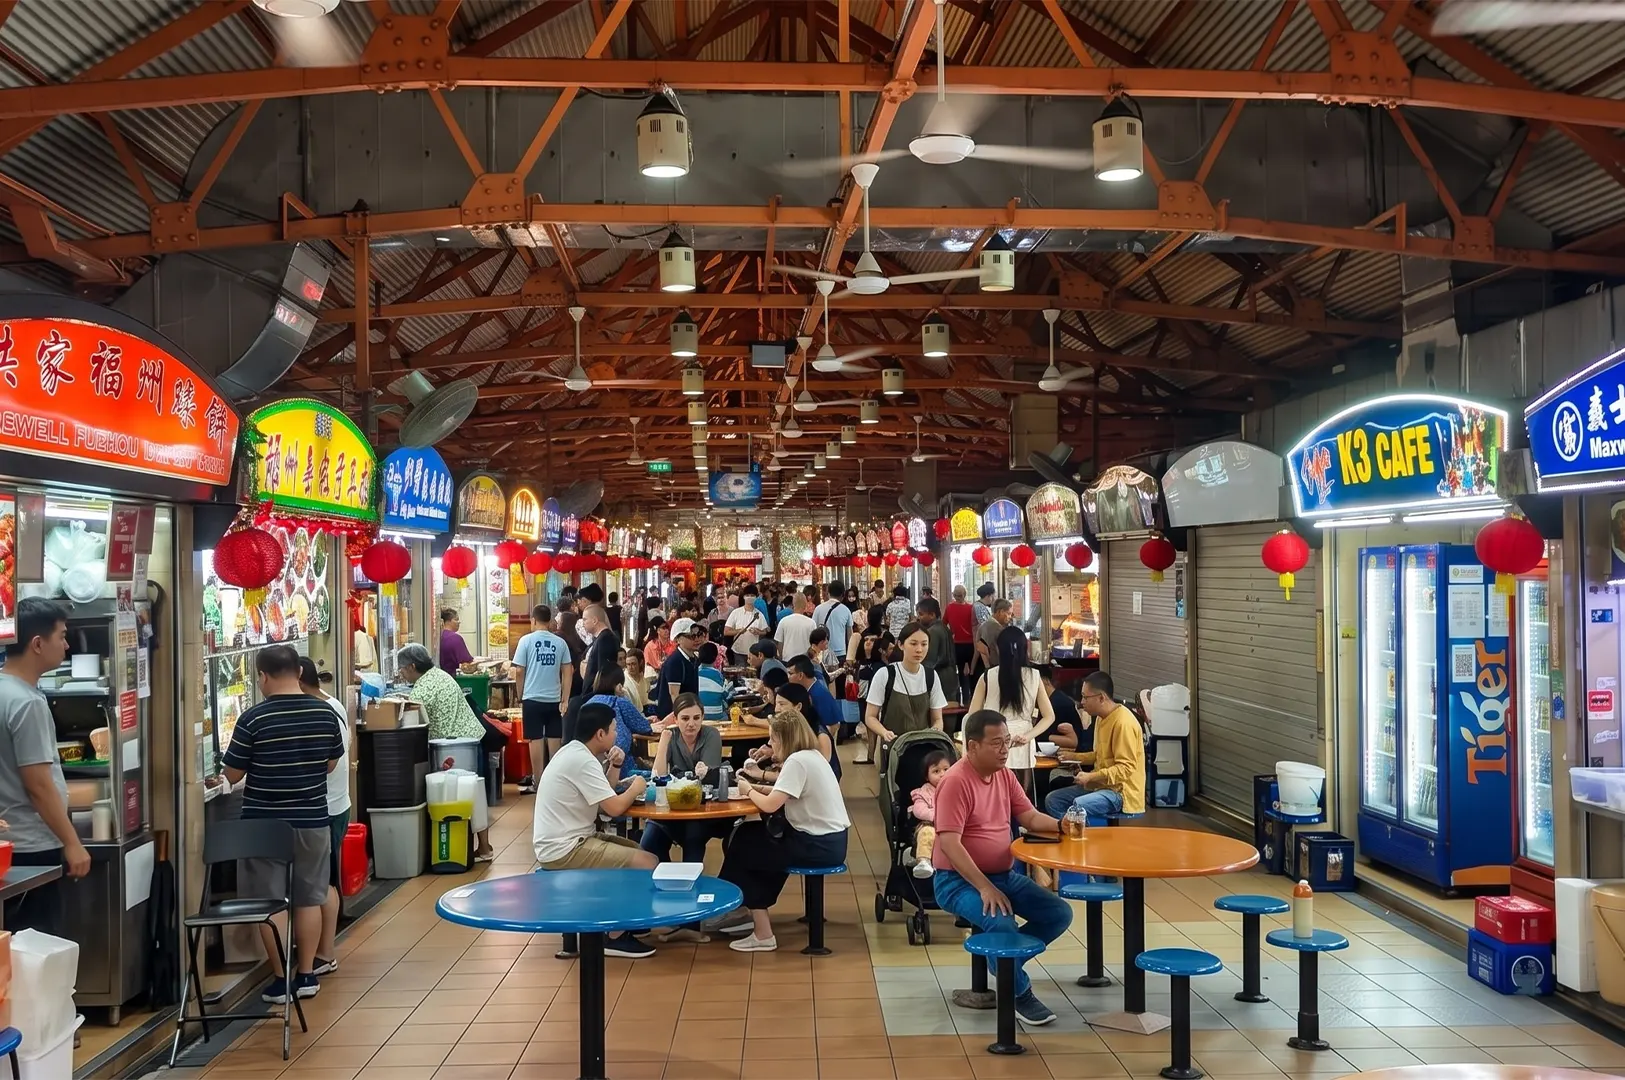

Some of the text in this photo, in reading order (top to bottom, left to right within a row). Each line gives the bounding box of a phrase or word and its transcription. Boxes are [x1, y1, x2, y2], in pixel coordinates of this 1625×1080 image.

[0, 411, 70, 446] EWELL
[1337, 424, 1434, 485] K3 CAFE
[1460, 639, 1510, 784] Tiger
